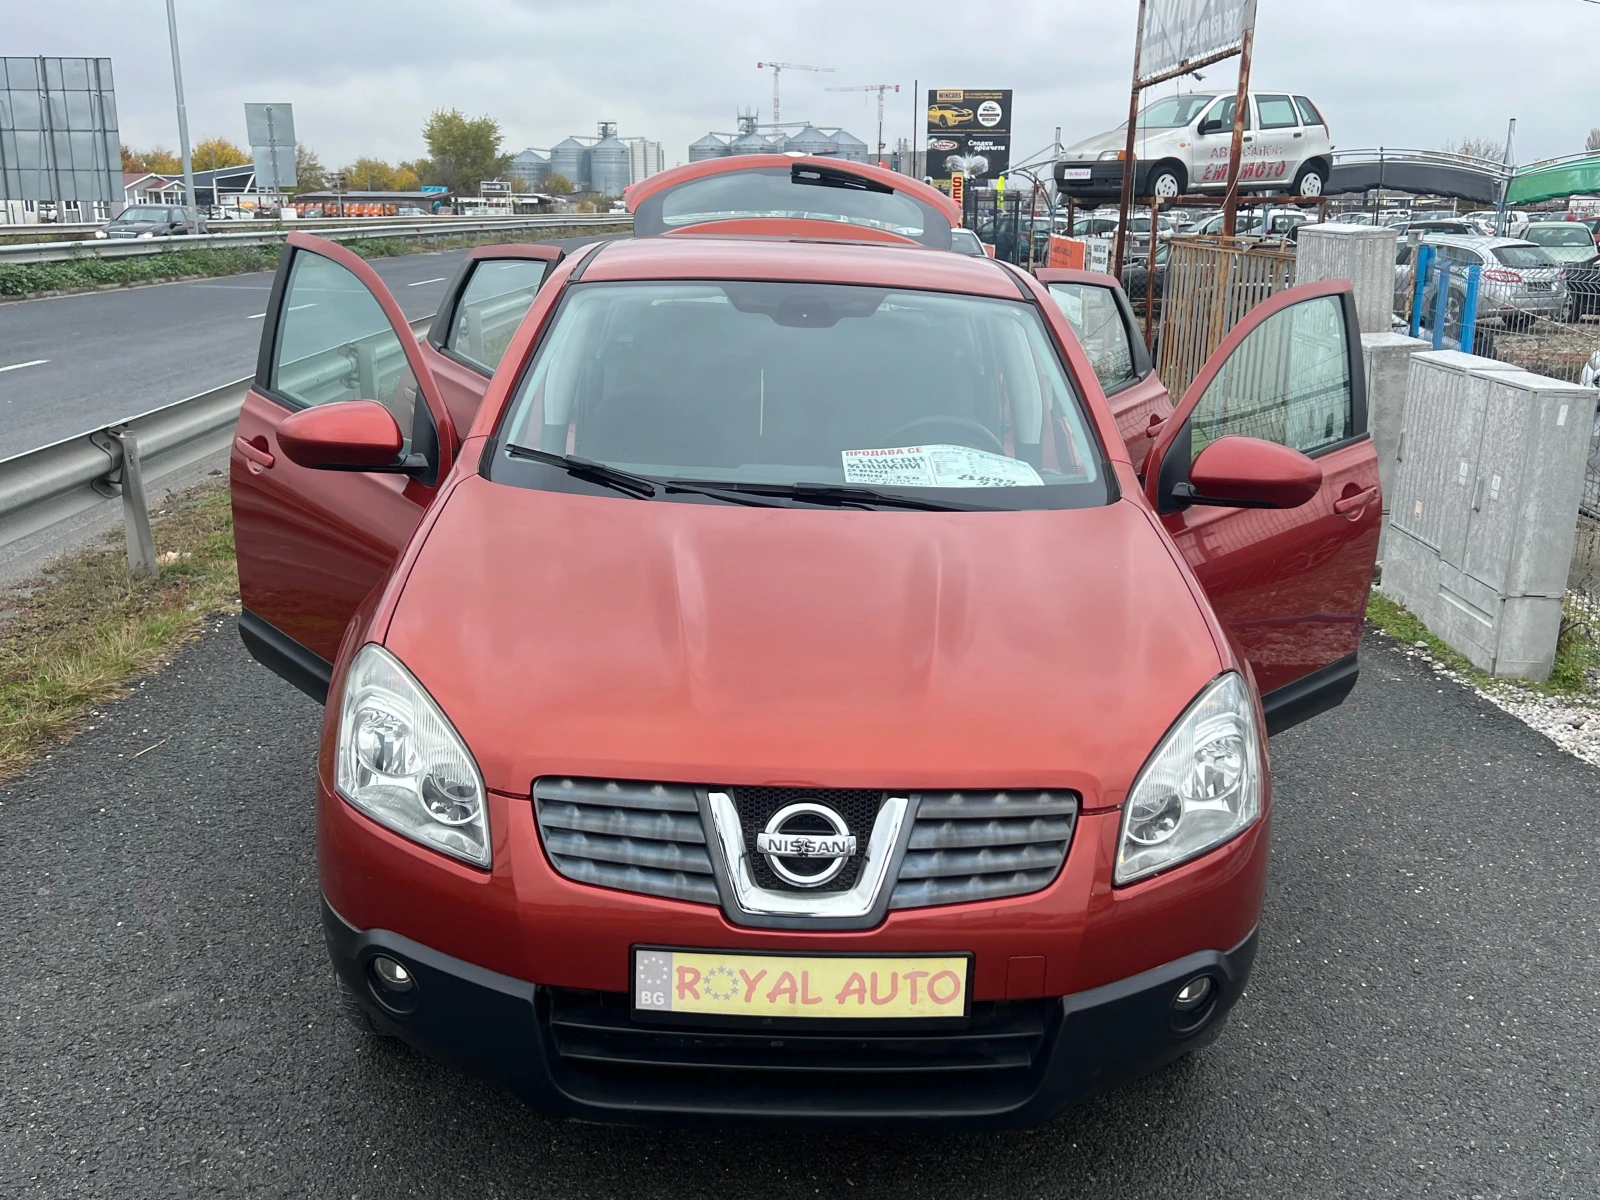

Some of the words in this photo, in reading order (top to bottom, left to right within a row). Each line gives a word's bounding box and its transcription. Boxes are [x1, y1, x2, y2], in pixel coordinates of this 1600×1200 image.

[845, 448, 904, 456] ПРОДАВА
[858, 456, 926, 464] НИСАН
[768, 839, 846, 853] NISSAN
[835, 970, 960, 1005] AUTO
[641, 991, 665, 1006] BG
